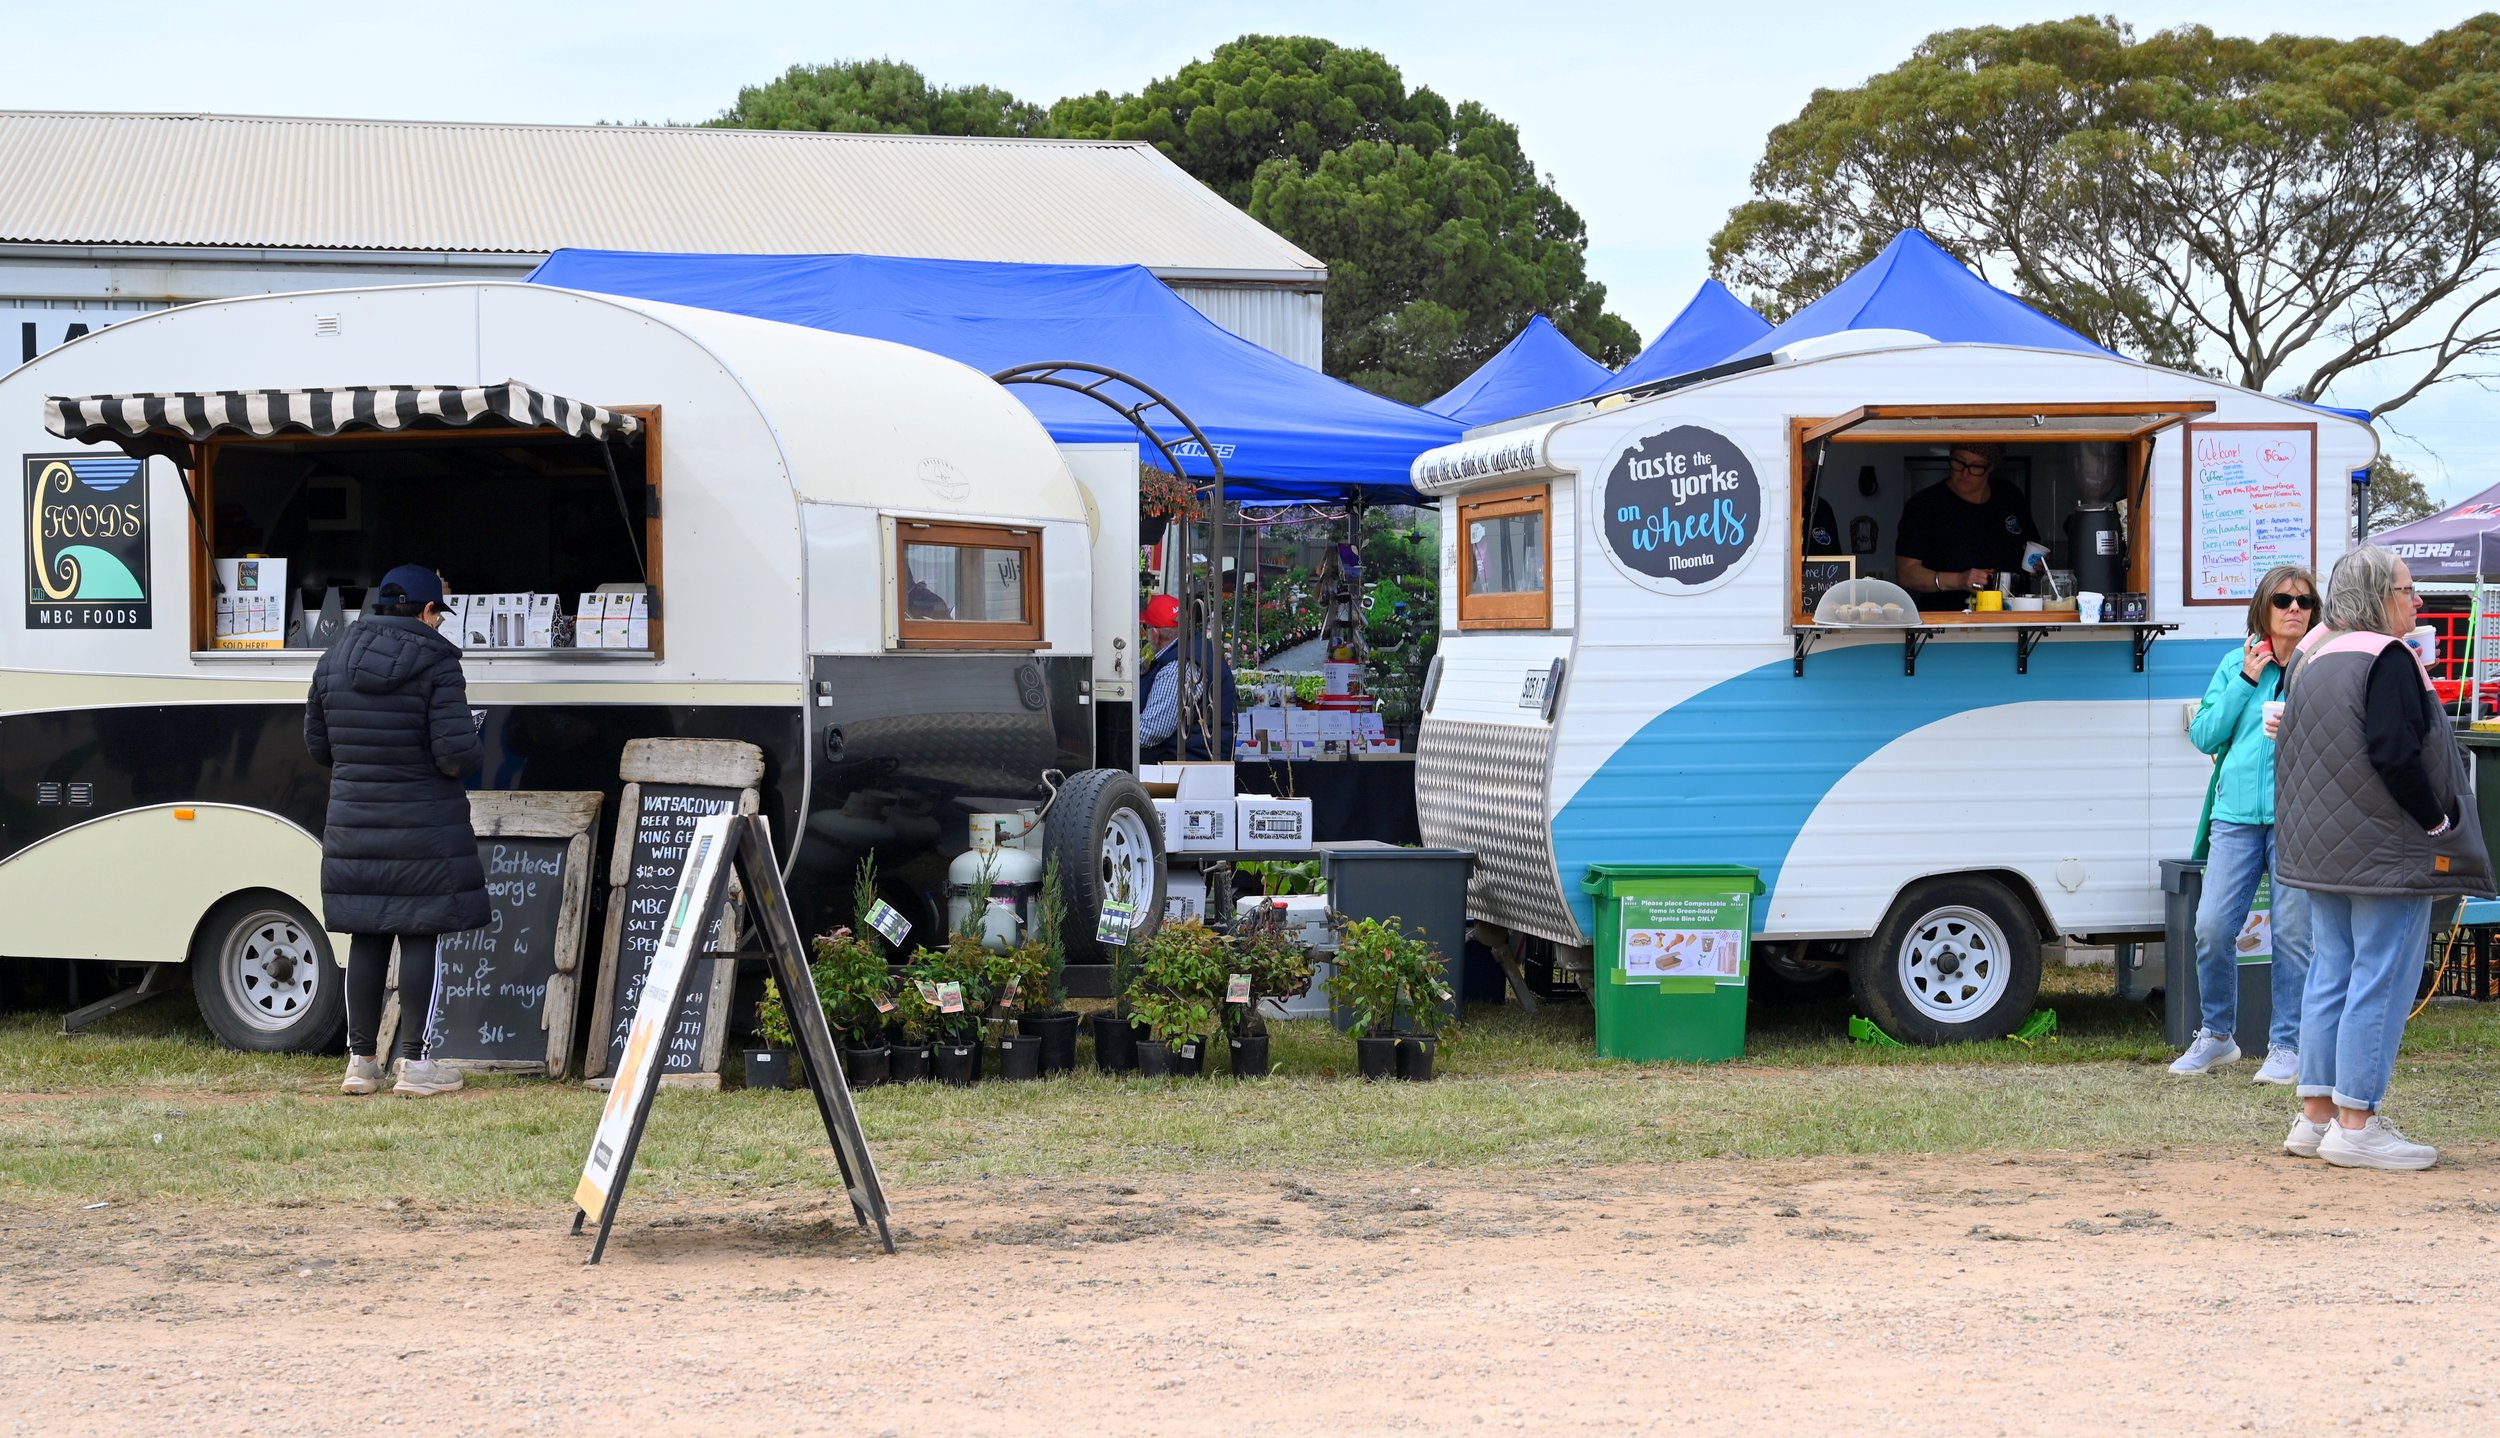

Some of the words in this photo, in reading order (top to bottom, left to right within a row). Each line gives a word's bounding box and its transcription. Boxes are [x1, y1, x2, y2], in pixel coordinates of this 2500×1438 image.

[1628, 452, 1687, 481] taste
[1693, 452, 1711, 466] the
[1670, 464, 1739, 506] yorke
[1617, 505, 1641, 522] on
[1632, 498, 1747, 551] wheels
[1669, 553, 1714, 571] Moonta
[40, 610, 73, 624] MBC
[84, 609, 137, 623] FOODS
[222, 641, 243, 649] SOLD
[246, 641, 269, 649] HERE!
[641, 815, 670, 827] BEER
[639, 830, 671, 844] KING
[490, 844, 563, 877] Battered
[652, 846, 688, 860] WHIT
[632, 898, 666, 914] MBC
[1665, 900, 1683, 908] place
[627, 919, 658, 931] SALT
[441, 929, 497, 952] rtilla
[439, 976, 491, 1005] ipotle
[500, 983, 546, 1008] mayo
